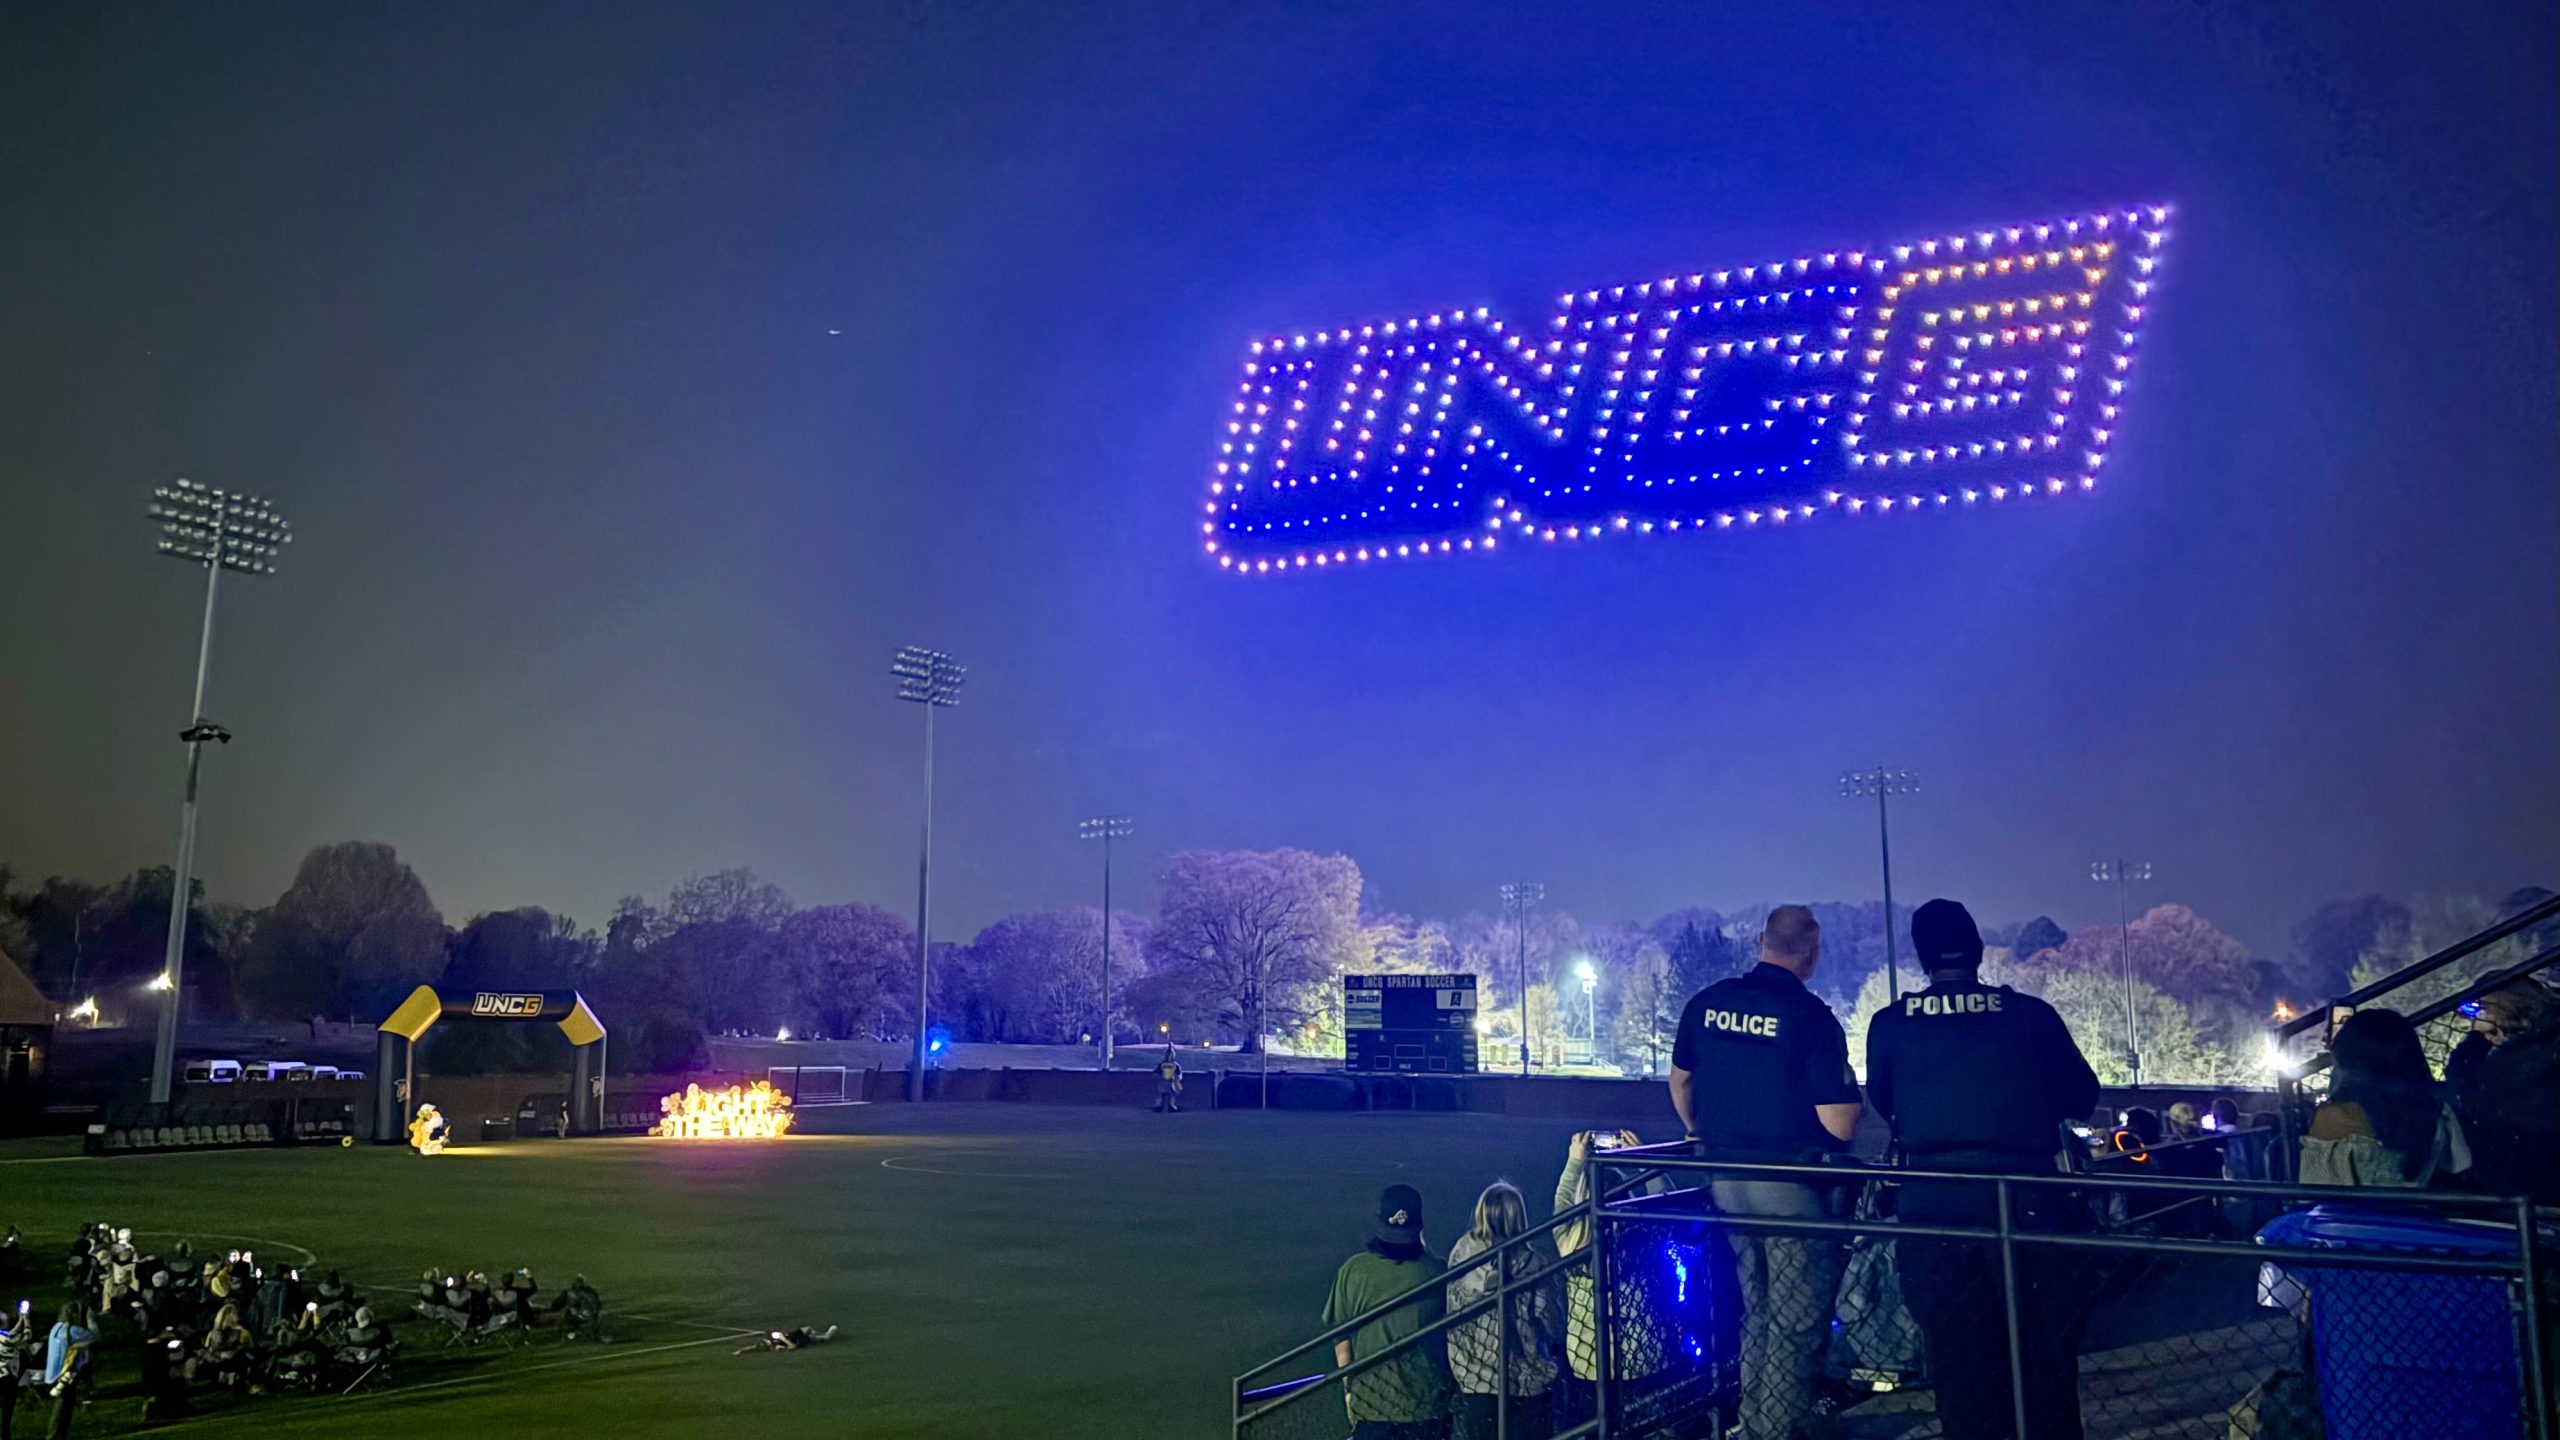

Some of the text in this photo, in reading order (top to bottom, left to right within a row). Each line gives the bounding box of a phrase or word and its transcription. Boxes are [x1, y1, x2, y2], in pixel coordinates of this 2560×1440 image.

[1203, 203, 2172, 572] UNCG
[1387, 976, 1421, 988] SPARTAN
[1425, 976, 1455, 988] SOCCER
[474, 994, 542, 1015] UNCG
[1905, 993, 2003, 1016] POLICE
[1704, 1009, 1778, 1037] POLICE
[691, 1093, 770, 1116] LIGHT
[671, 1113, 781, 1137] THE WAY
